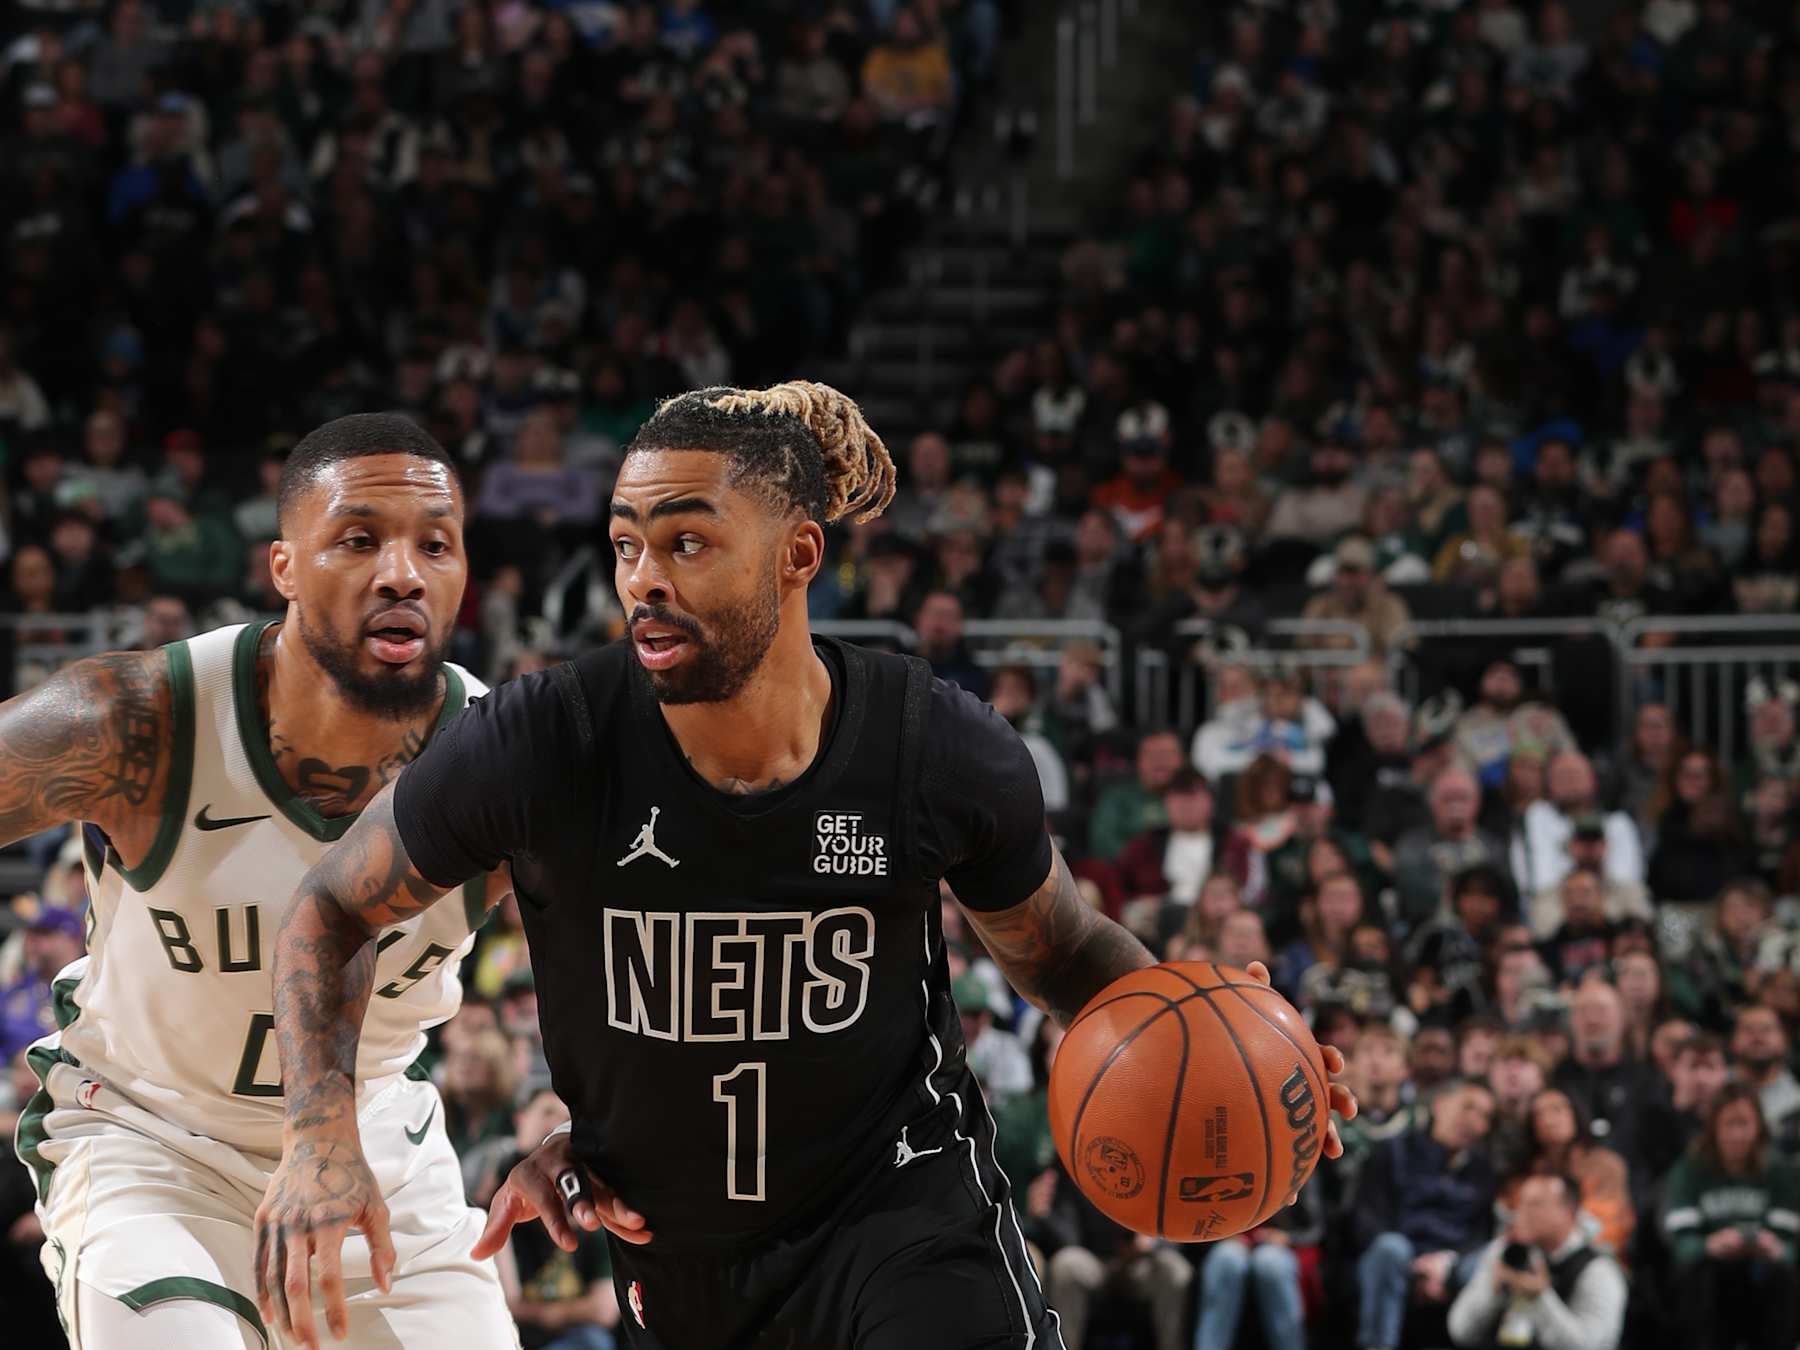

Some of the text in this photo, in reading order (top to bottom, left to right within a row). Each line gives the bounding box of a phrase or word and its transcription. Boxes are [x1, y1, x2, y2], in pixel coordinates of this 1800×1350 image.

[815, 834, 885, 855] YOUR
[816, 814, 863, 834] GET
[813, 854, 888, 876] GUIDE
[147, 902, 456, 1000] BUS
[603, 905, 875, 1042] NETS
[712, 1061, 766, 1201] 1
